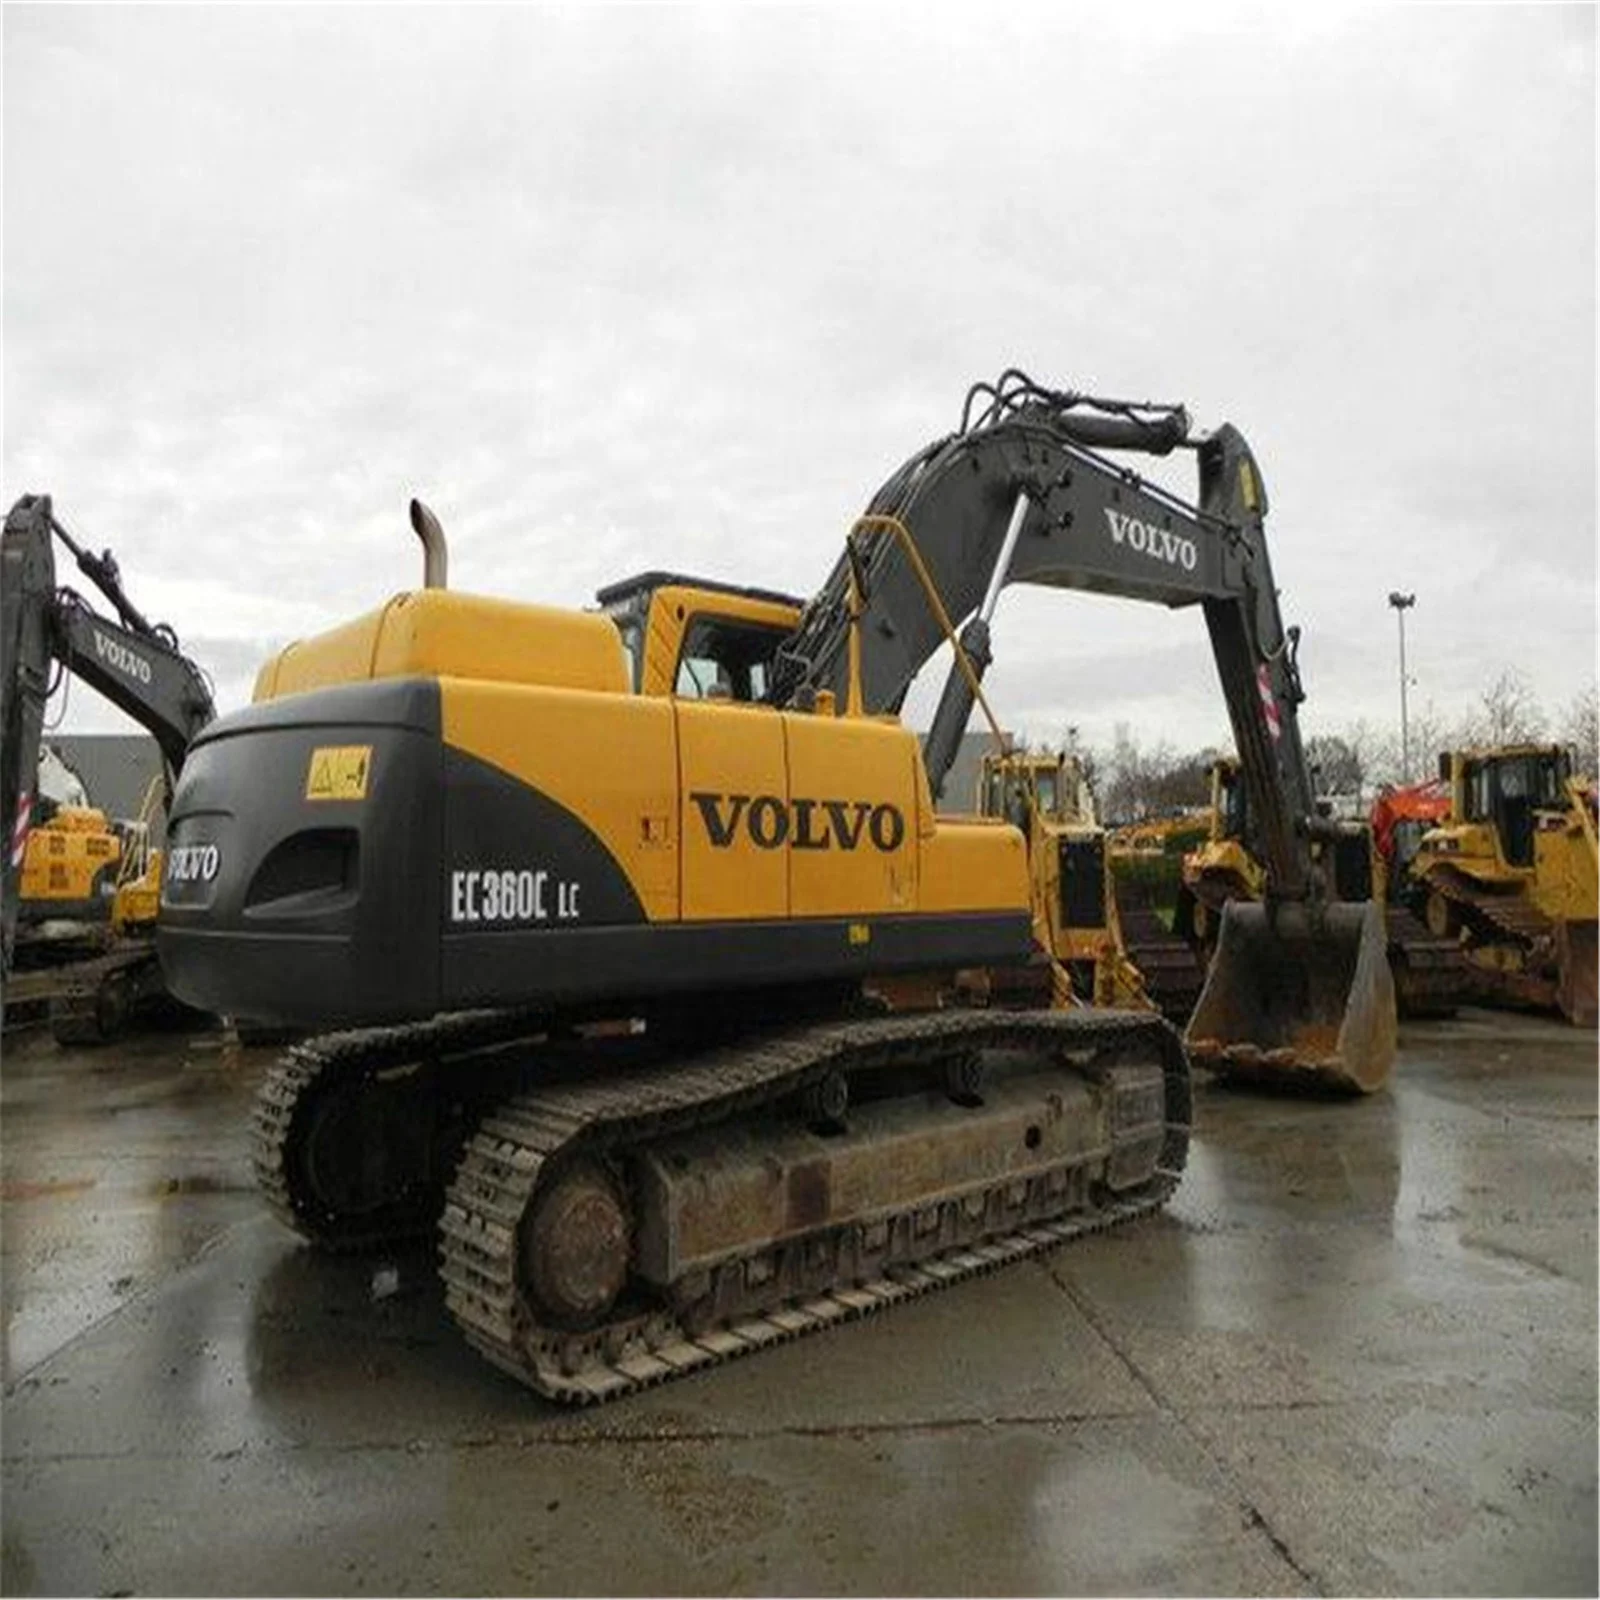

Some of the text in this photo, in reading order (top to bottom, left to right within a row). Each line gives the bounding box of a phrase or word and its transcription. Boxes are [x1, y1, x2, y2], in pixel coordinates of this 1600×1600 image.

[1104, 508, 1197, 570] VOLVO
[93, 629, 151, 684] VOLVO
[690, 792, 904, 852] VOLVO
[451, 869, 580, 921] EC360C LC
